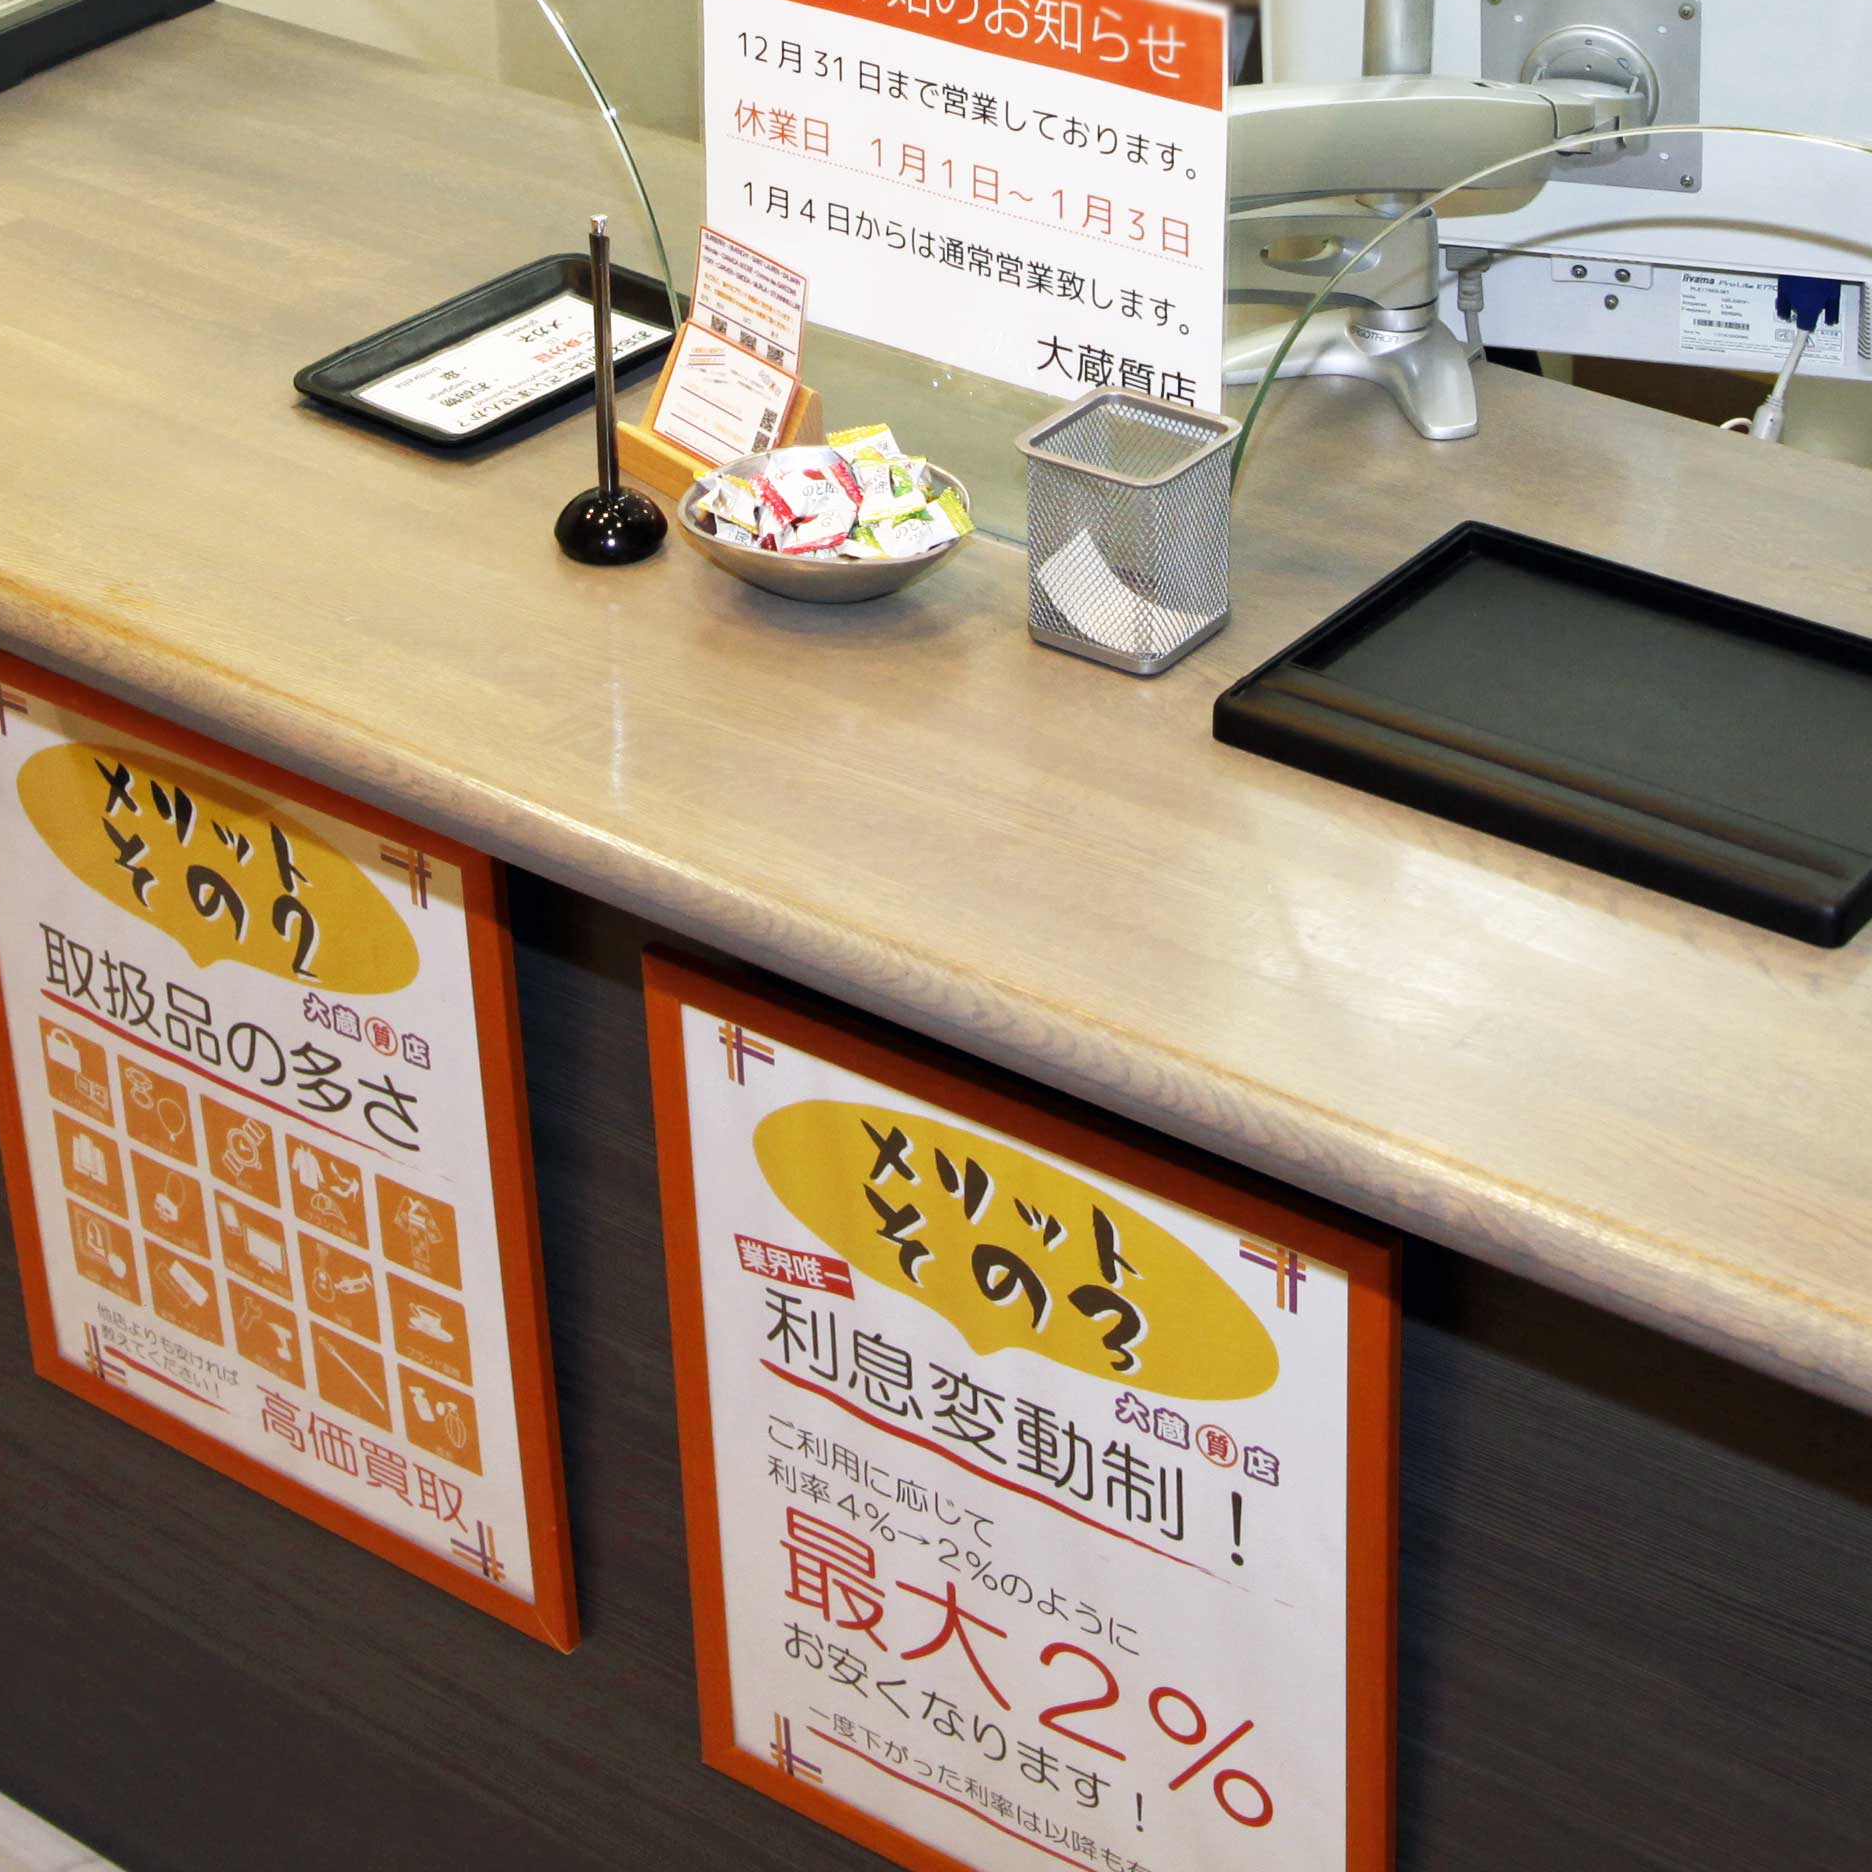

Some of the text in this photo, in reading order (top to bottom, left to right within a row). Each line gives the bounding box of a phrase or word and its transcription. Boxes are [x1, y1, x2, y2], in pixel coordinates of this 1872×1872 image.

[733, 99, 830, 157] 休業日
[1037, 335, 1197, 408] 大蔵質店
[94, 757, 312, 886] メリット
[38, 920, 424, 1155] 取扱品の多さ
[301, 990, 432, 1072] 大蔵質店
[737, 1236, 851, 1296] 業界唯一
[860, 1118, 1142, 1288] メリット
[97, 1302, 240, 1387] 他店よりも安ければ
[256, 1383, 469, 1534] 高価買取
[764, 1287, 1246, 1569] 利息変動制！
[766, 1414, 997, 1549] ご利用に応じて
[1113, 1391, 1283, 1489] 大蔵質店
[781, 1506, 1276, 1830] 最大2%
[782, 1621, 1150, 1834] お安くなります！
